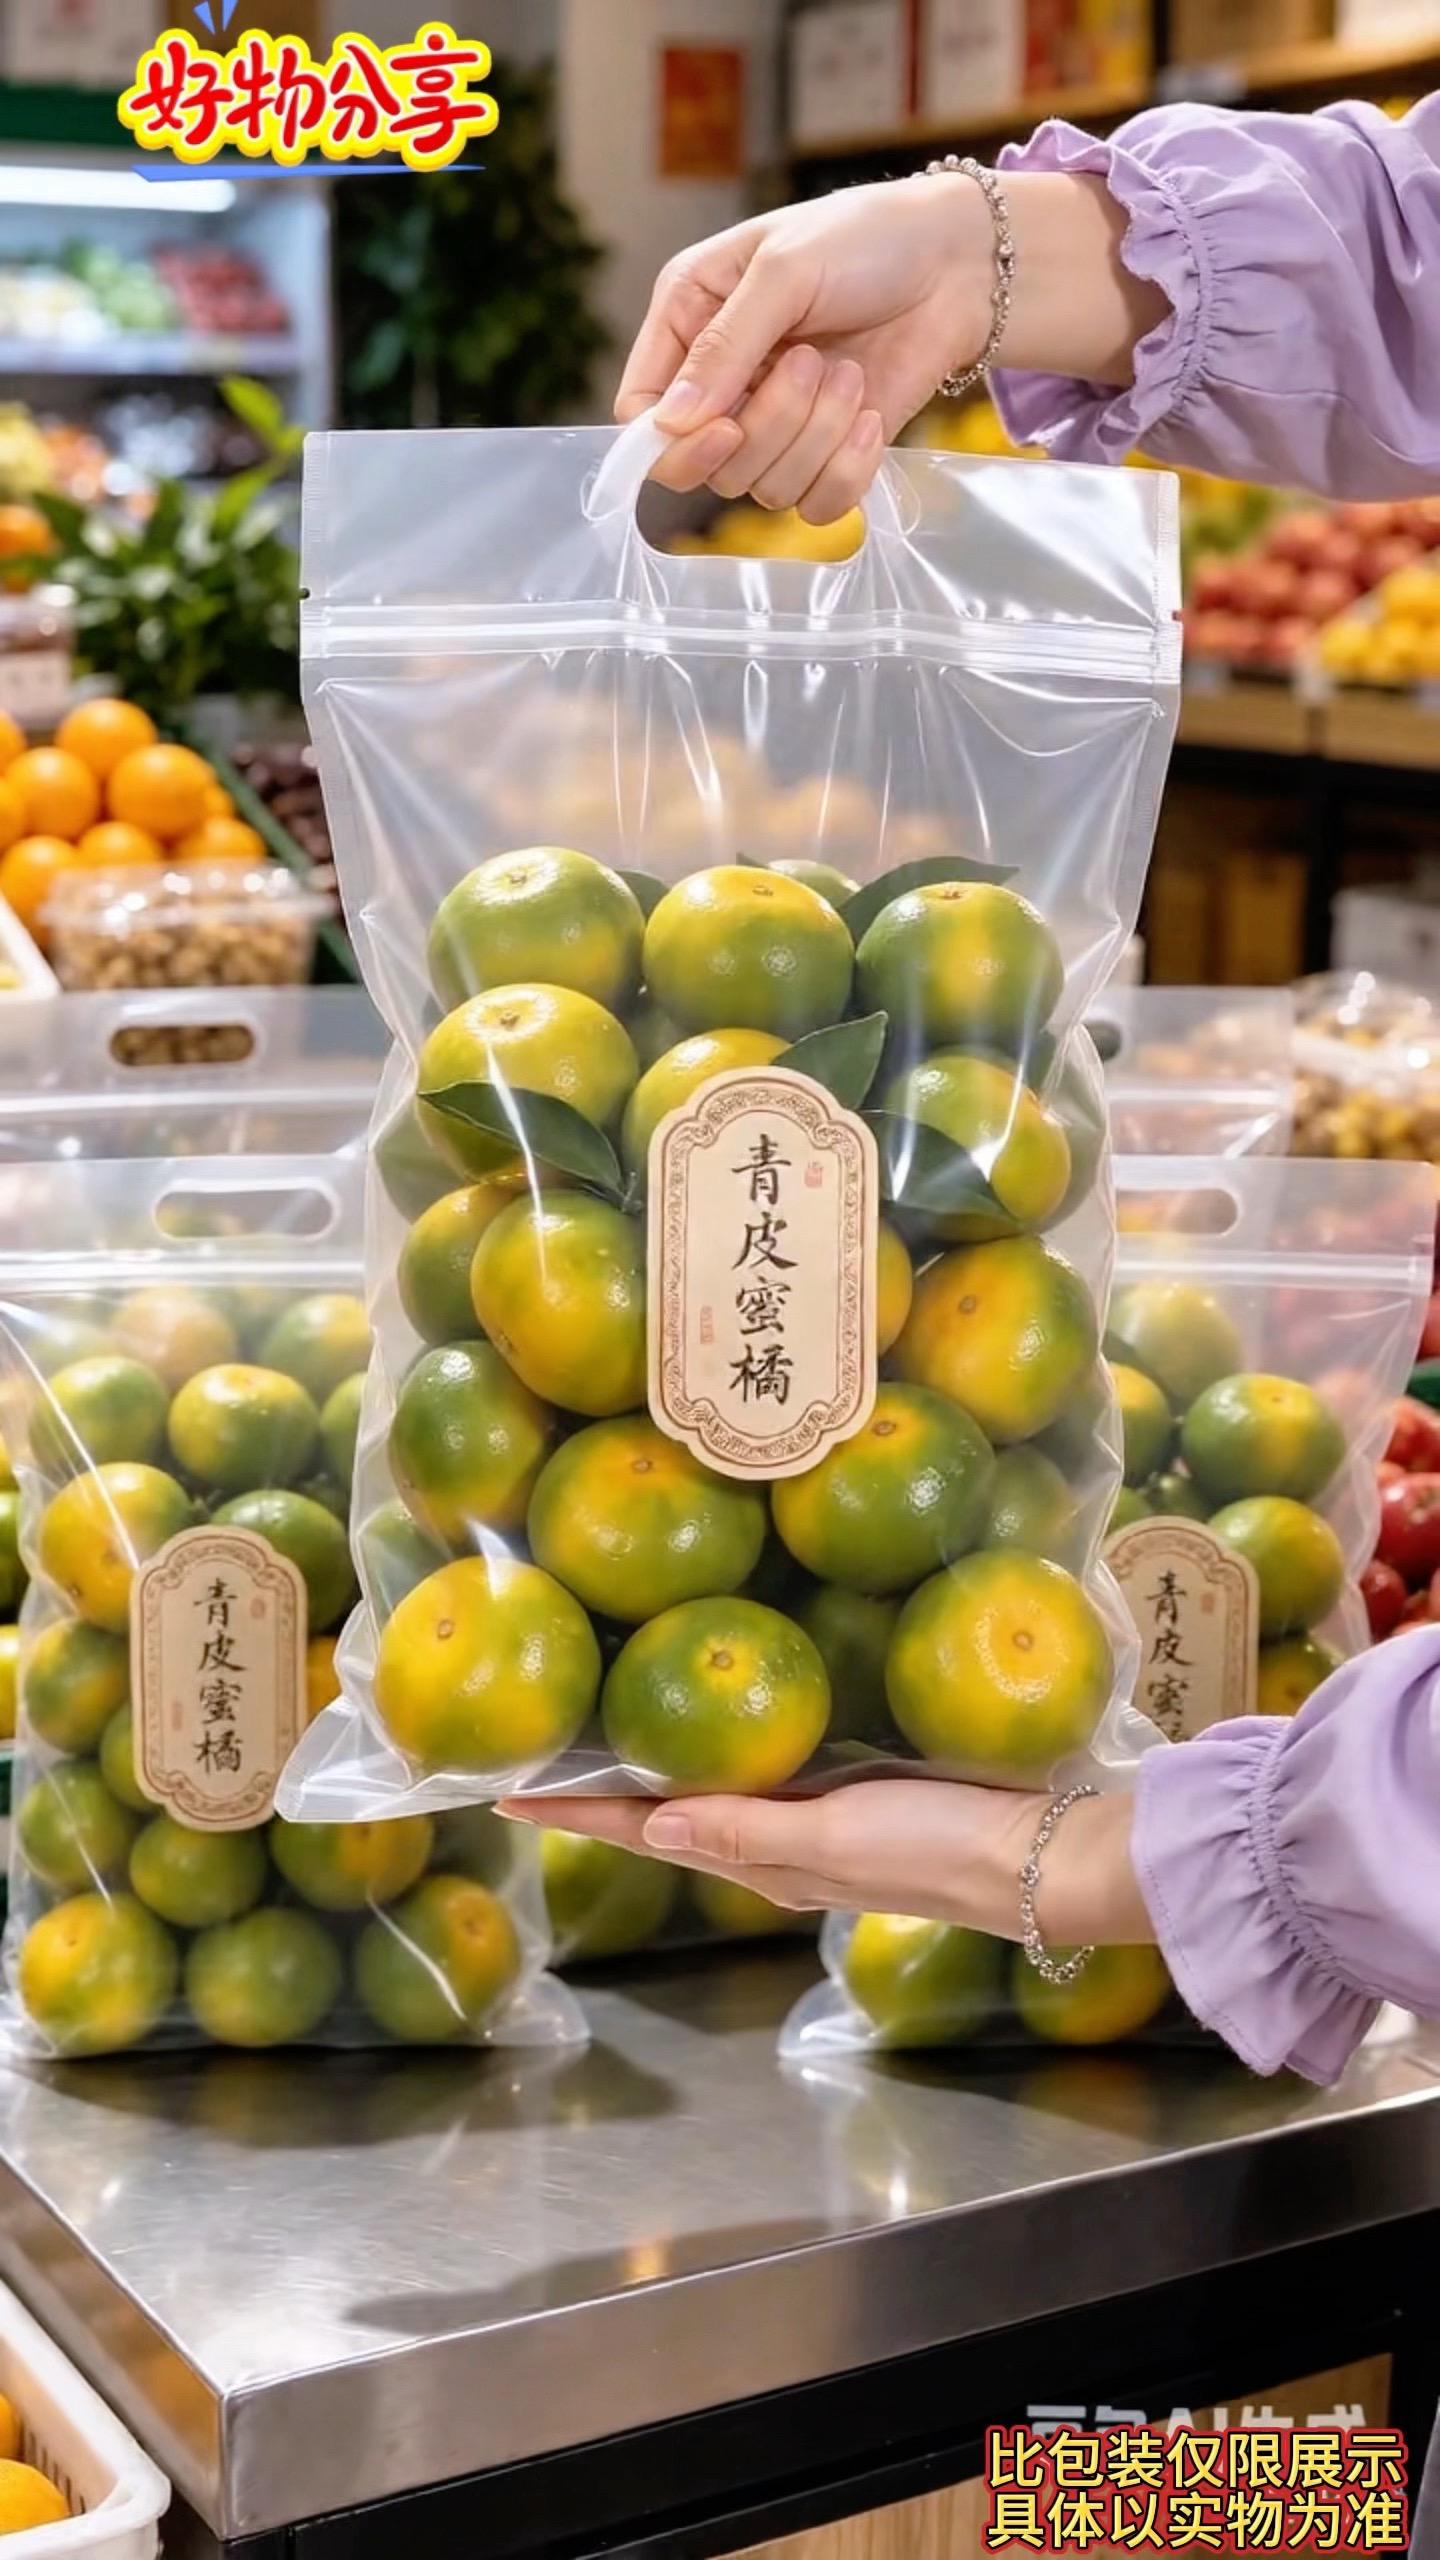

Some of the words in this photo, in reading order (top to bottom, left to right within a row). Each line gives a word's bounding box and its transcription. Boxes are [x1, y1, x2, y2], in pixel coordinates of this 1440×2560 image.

[729, 1133, 798, 1406] 青皮蜜橘
[194, 1577, 246, 1779] 青皮蜜橘
[1146, 1570, 1194, 1741] 青皮蜜
